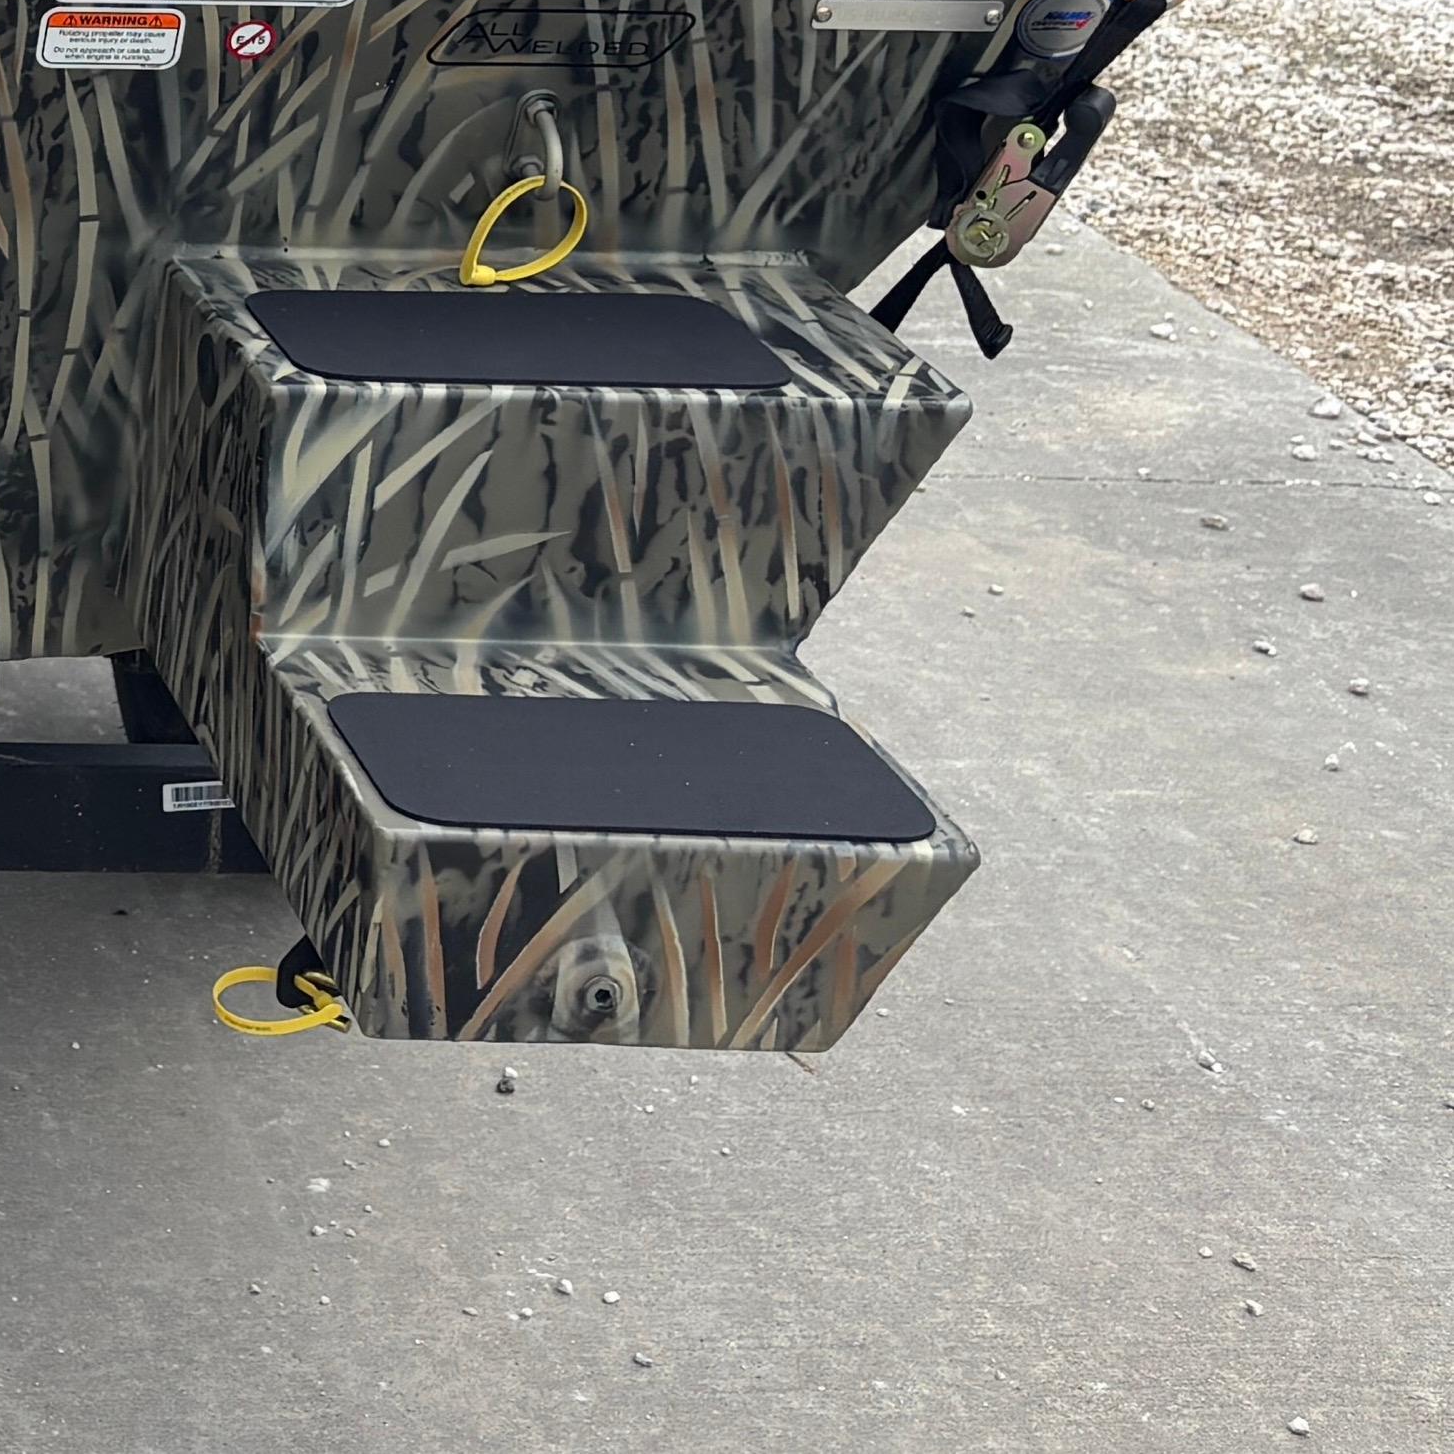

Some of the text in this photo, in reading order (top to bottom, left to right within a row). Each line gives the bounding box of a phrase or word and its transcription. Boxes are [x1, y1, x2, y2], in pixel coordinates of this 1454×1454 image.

[80, 16, 148, 26] WARNING
[458, 22, 524, 44] ALL
[490, 38, 649, 57] WELDED
